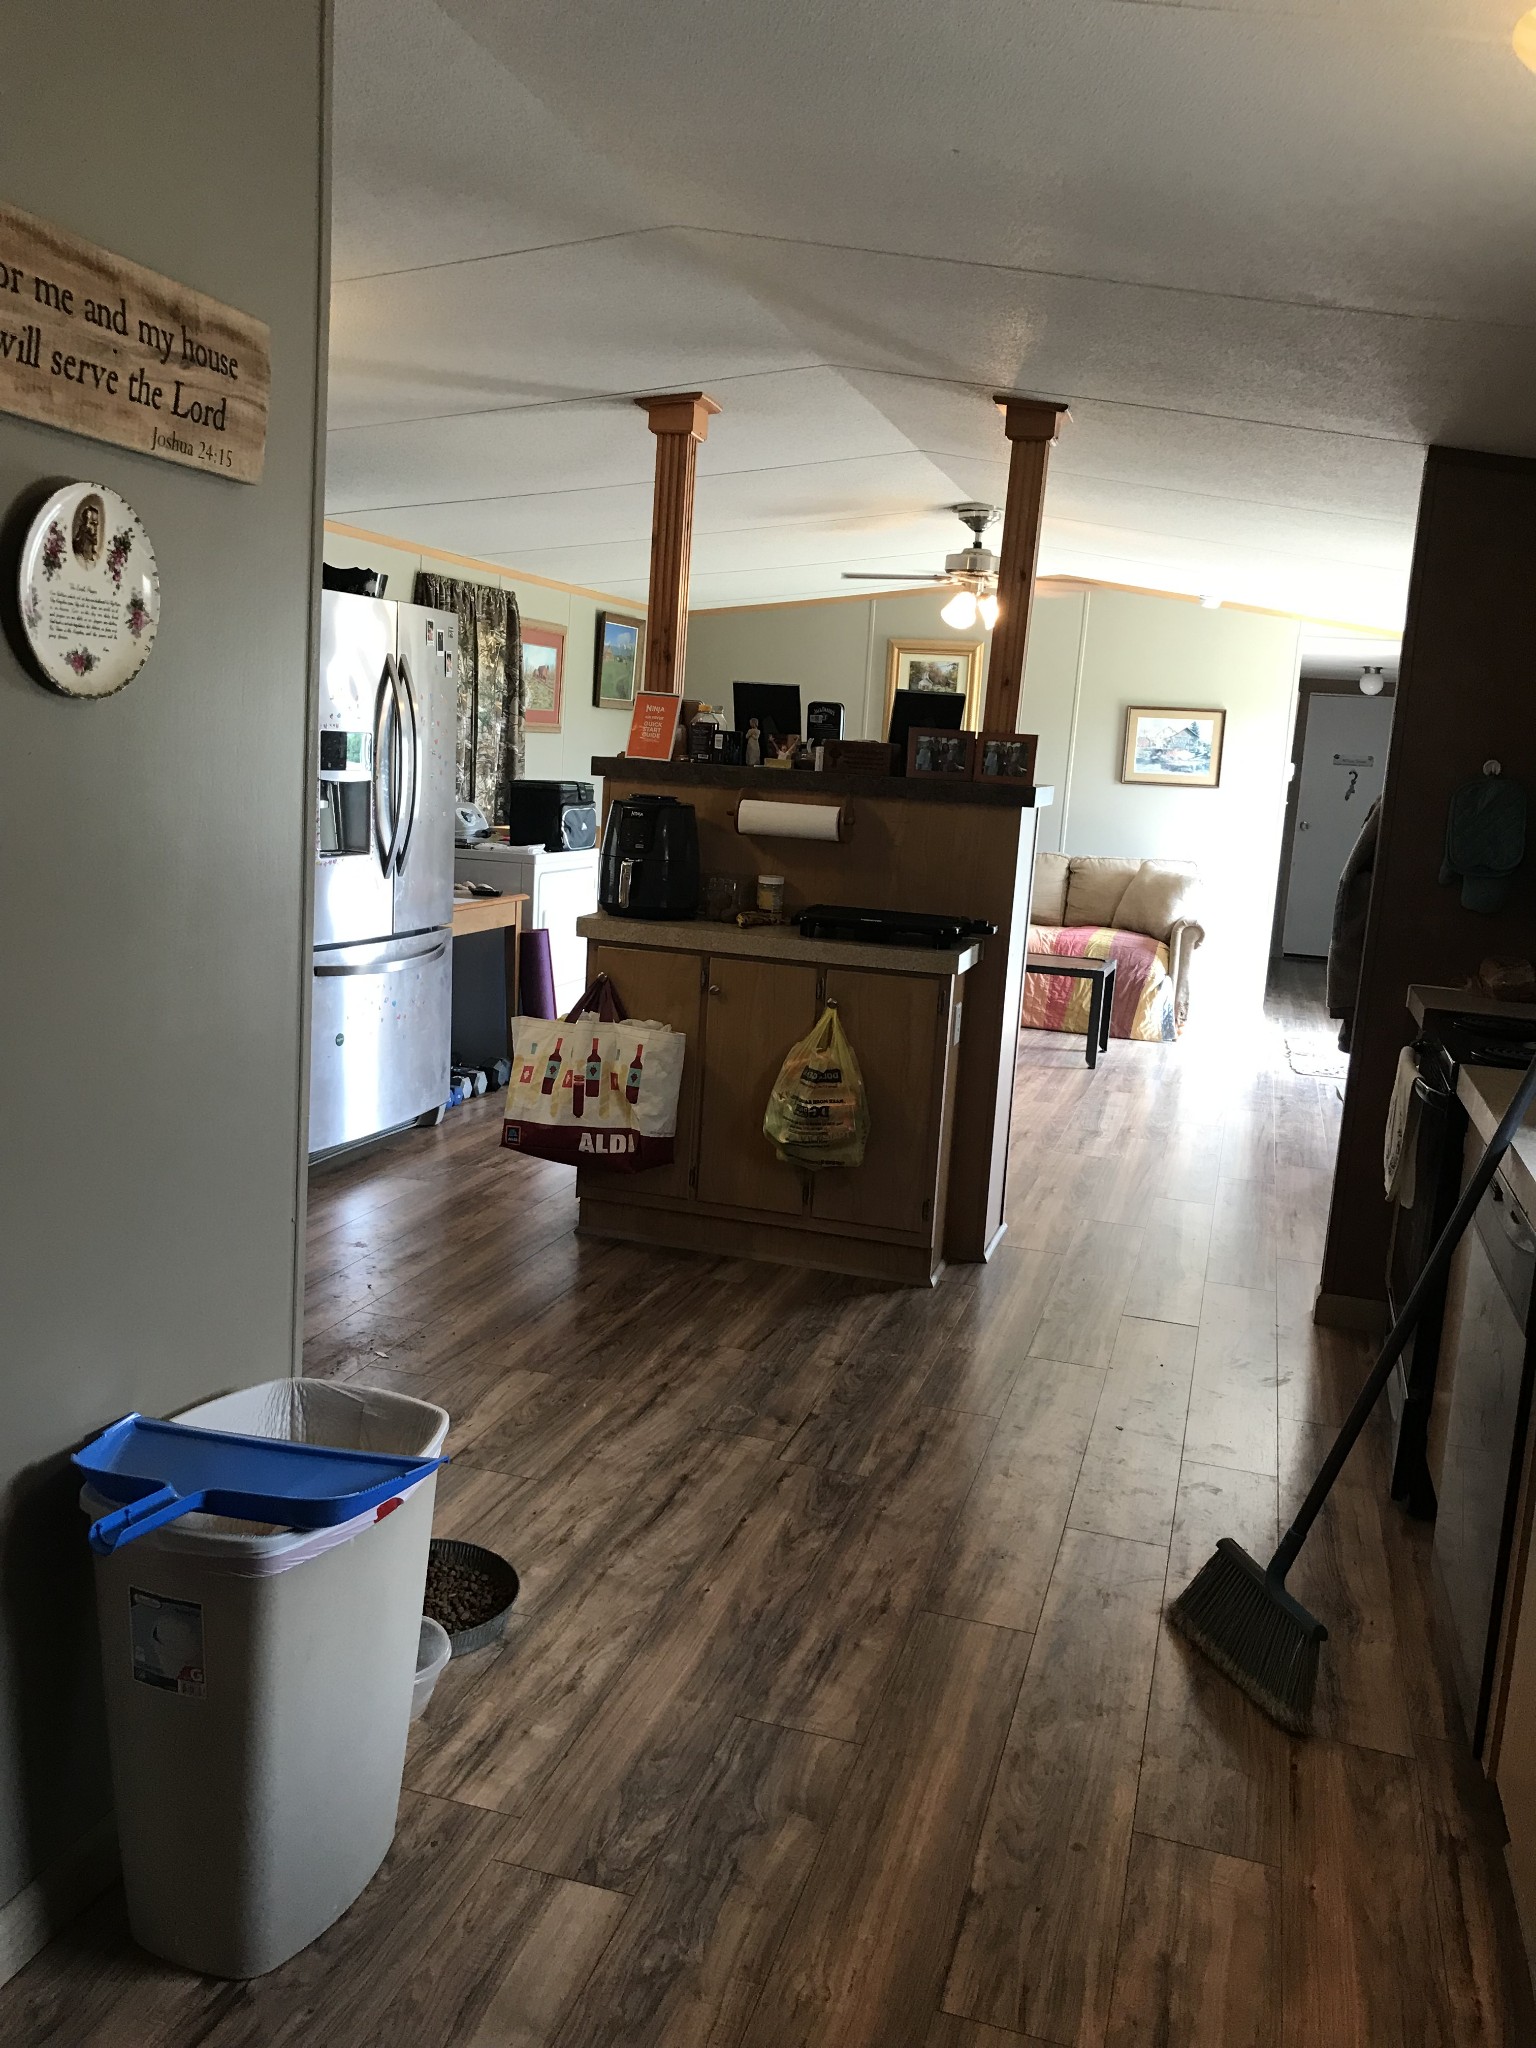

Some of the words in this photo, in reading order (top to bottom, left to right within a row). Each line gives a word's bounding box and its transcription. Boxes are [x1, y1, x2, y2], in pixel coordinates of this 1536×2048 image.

[35, 276, 73, 315] me
[85, 298, 129, 336] and
[138, 319, 174, 365] my
[181, 325, 239, 380] house
[0, 325, 41, 369] will
[51, 350, 119, 395] serve
[128, 367, 162, 411] the
[171, 380, 227, 431] Lord
[150, 427, 193, 456] Joshua
[198, 441, 233, 468] 24:15
[643, 720, 663, 728] QUICK
[645, 704, 665, 714] NINJA
[578, 1132, 635, 1154] ALDI
